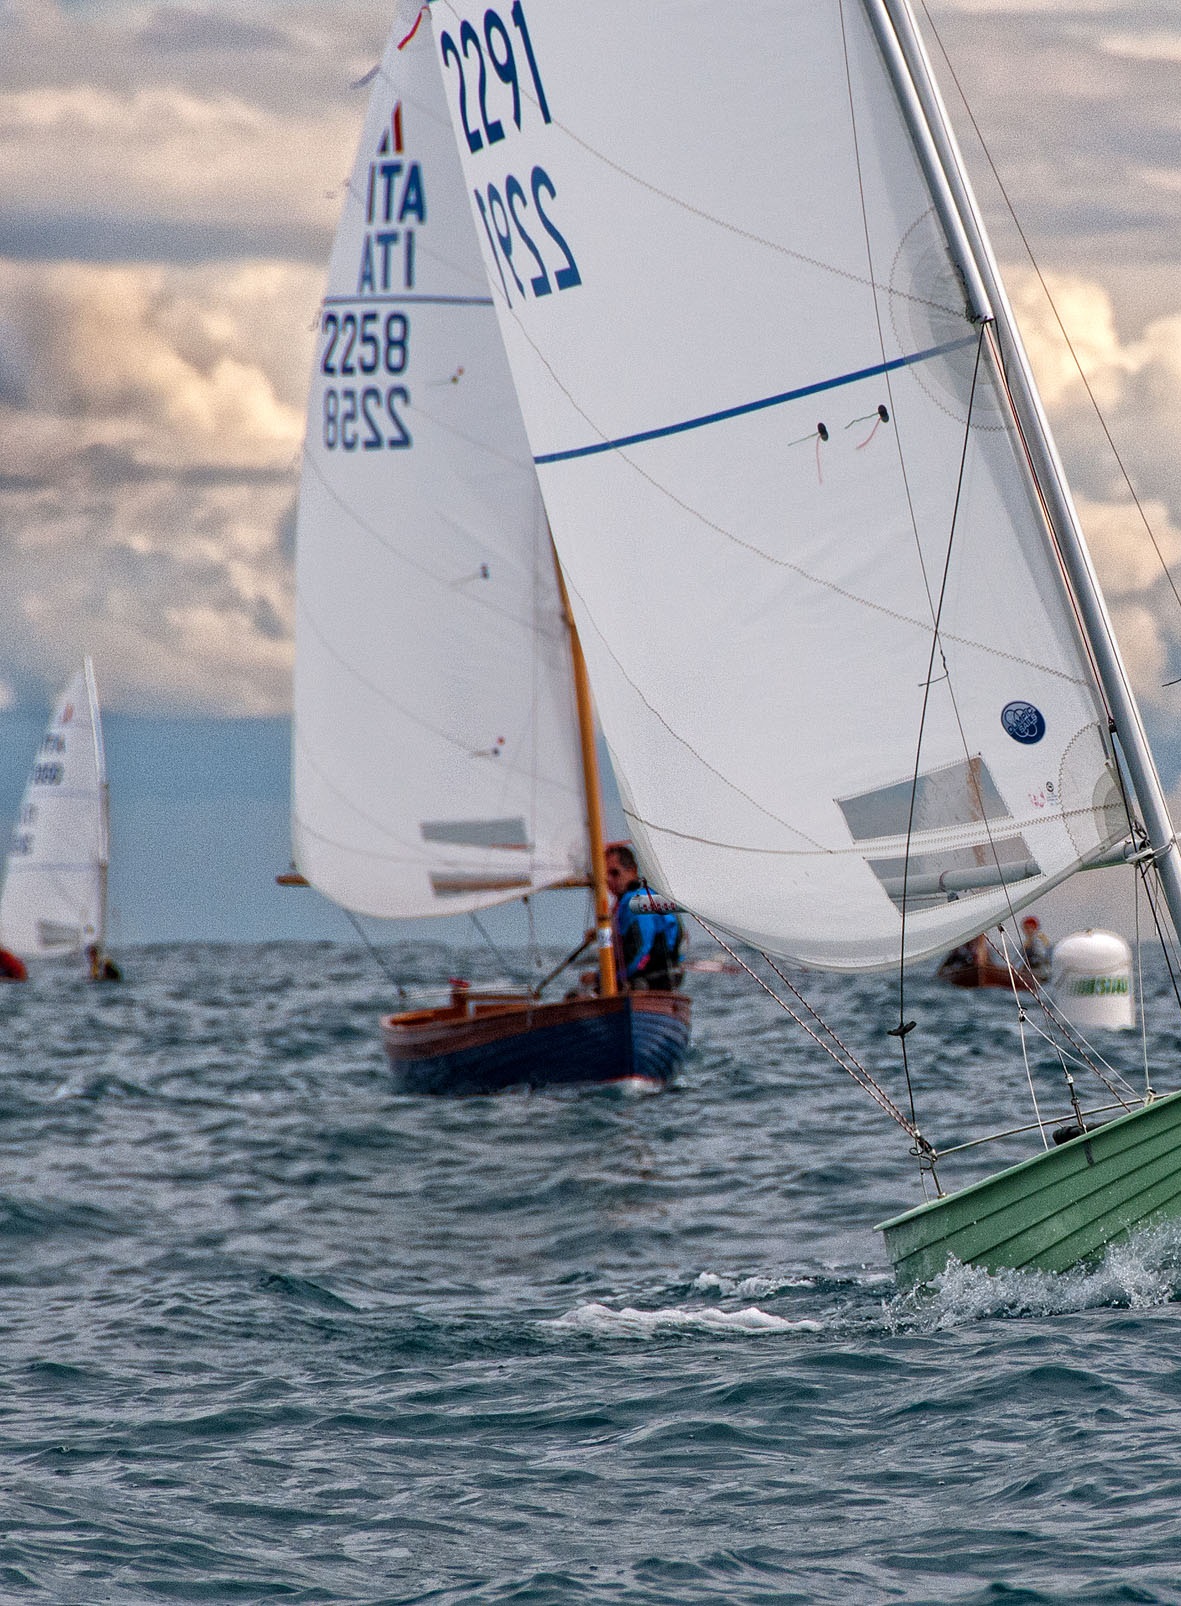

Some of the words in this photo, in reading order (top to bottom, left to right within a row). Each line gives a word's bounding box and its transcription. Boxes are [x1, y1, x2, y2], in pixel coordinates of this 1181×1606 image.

[441, 0, 551, 154] 2291
[367, 161, 426, 225] ITA
[321, 311, 410, 375] 2258
[1019, 714, 1038, 735] SAILS
